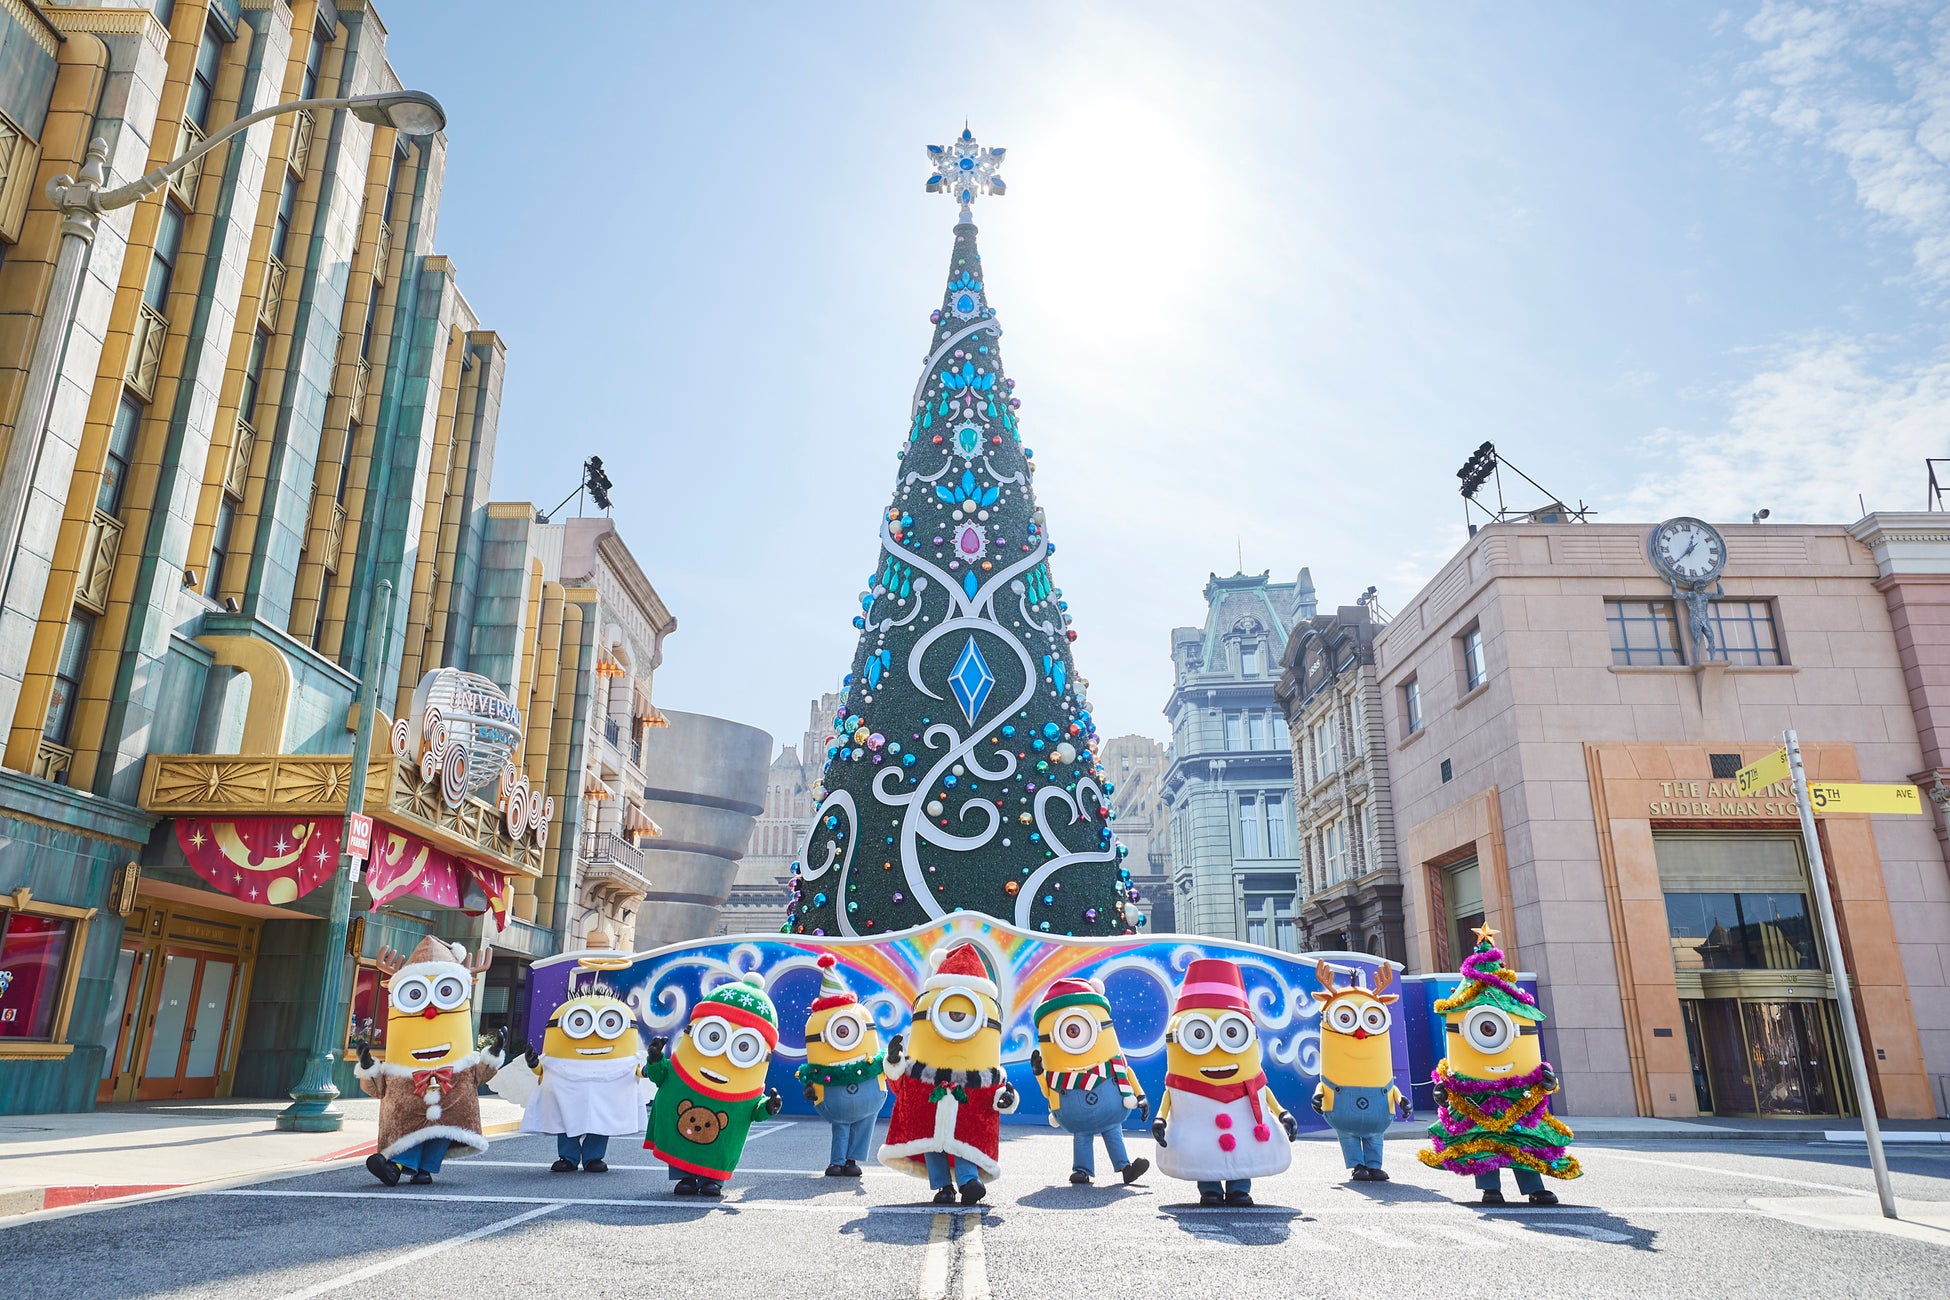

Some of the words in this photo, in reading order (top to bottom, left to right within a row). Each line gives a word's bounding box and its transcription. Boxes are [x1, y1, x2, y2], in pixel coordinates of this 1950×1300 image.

[450, 690, 521, 730] UNIVERSAL
[1739, 768, 1758, 791] 57TH
[1660, 782, 1700, 798] THE
[1707, 782, 1798, 798] AMZIN
[1813, 788, 1841, 807] 5TH
[1896, 789, 1916, 799] AVE.
[1649, 802, 1759, 816] SPIDER-MAN
[353, 819, 369, 838] NO
